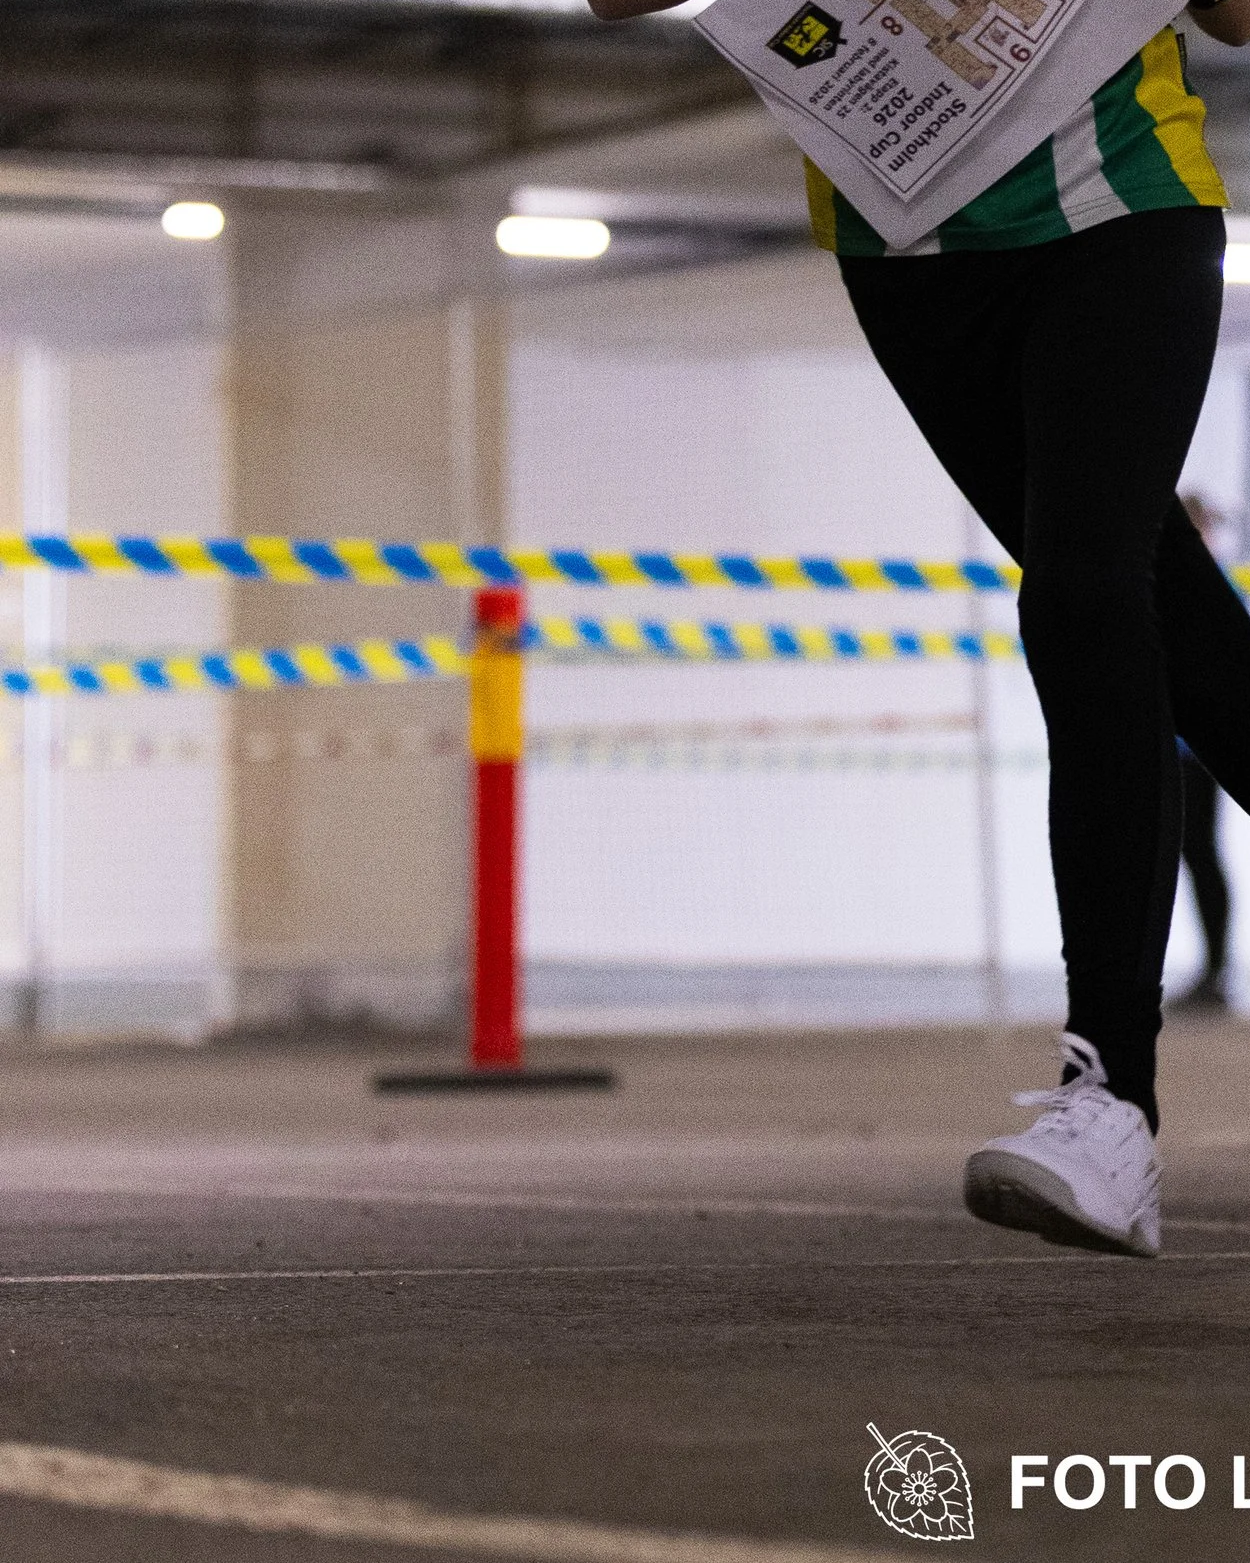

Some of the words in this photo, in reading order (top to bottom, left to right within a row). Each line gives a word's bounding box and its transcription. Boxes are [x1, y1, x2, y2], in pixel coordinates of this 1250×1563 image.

[881, 15, 903, 36] 8
[812, 38, 833, 58] SIC
[868, 47, 889, 69] med
[1010, 43, 1031, 62] 9
[832, 45, 870, 81] februari
[809, 80, 835, 104] 2026
[823, 67, 871, 111] labyrinten
[849, 58, 899, 105] Kistavägen
[871, 78, 899, 103] Etapp
[837, 105, 852, 119] 25
[873, 87, 914, 126] 2026
[900, 81, 953, 131] Indoor
[869, 131, 901, 158] Cup
[888, 98, 967, 172] Stockholm
